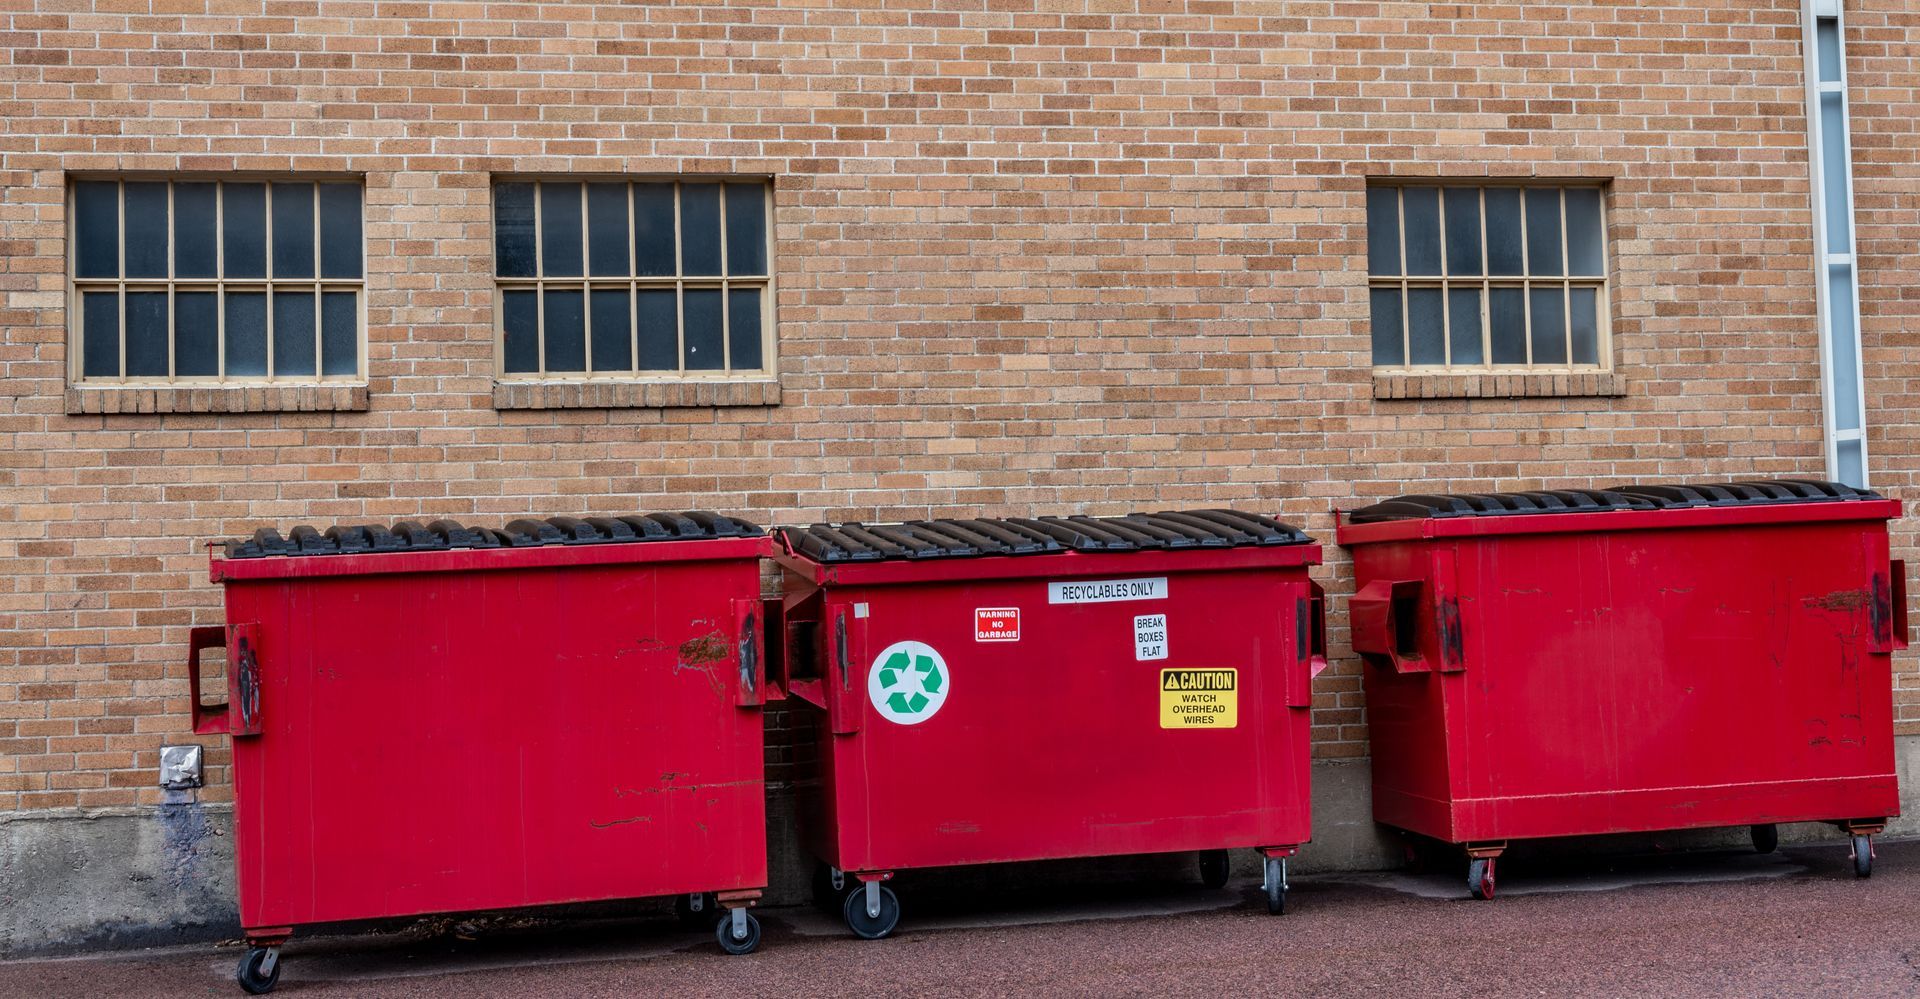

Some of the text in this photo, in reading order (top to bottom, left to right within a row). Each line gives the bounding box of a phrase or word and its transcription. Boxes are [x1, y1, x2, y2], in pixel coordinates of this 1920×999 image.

[1062, 582, 1154, 600] RECYCLABLES ONLY
[1137, 617, 1164, 629] BREAK
[1138, 631, 1164, 643] BOXES
[1142, 646, 1161, 657] FLAT
[1180, 672, 1232, 690] CAUTION
[1182, 694, 1217, 703] WATCH
[1172, 705, 1226, 714] OVERHEAD
[1184, 716, 1215, 724] WIRES
